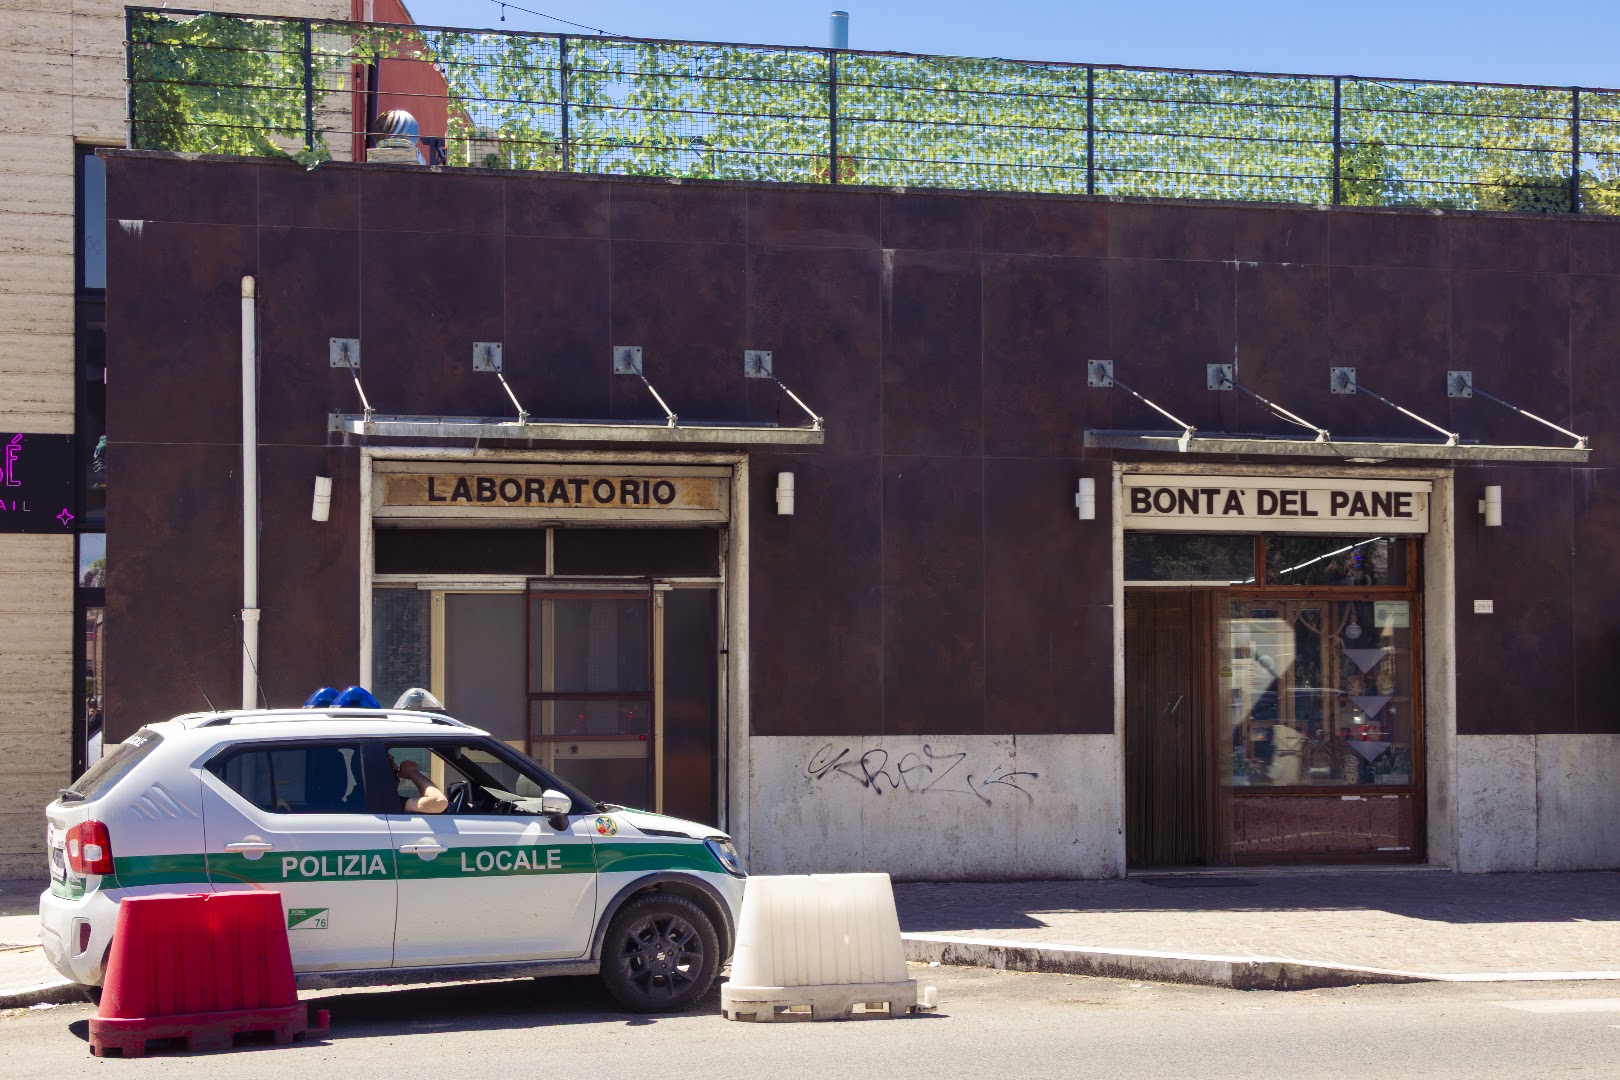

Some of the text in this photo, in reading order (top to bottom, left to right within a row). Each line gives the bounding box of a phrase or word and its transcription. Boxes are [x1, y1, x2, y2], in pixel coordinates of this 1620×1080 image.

[428, 476, 676, 505] LABORATORIO
[1257, 489, 1318, 517] DEL
[1330, 491, 1413, 518] PANE
[281, 849, 562, 878] POLIZIA LOCALE
[315, 918, 327, 928] 76
